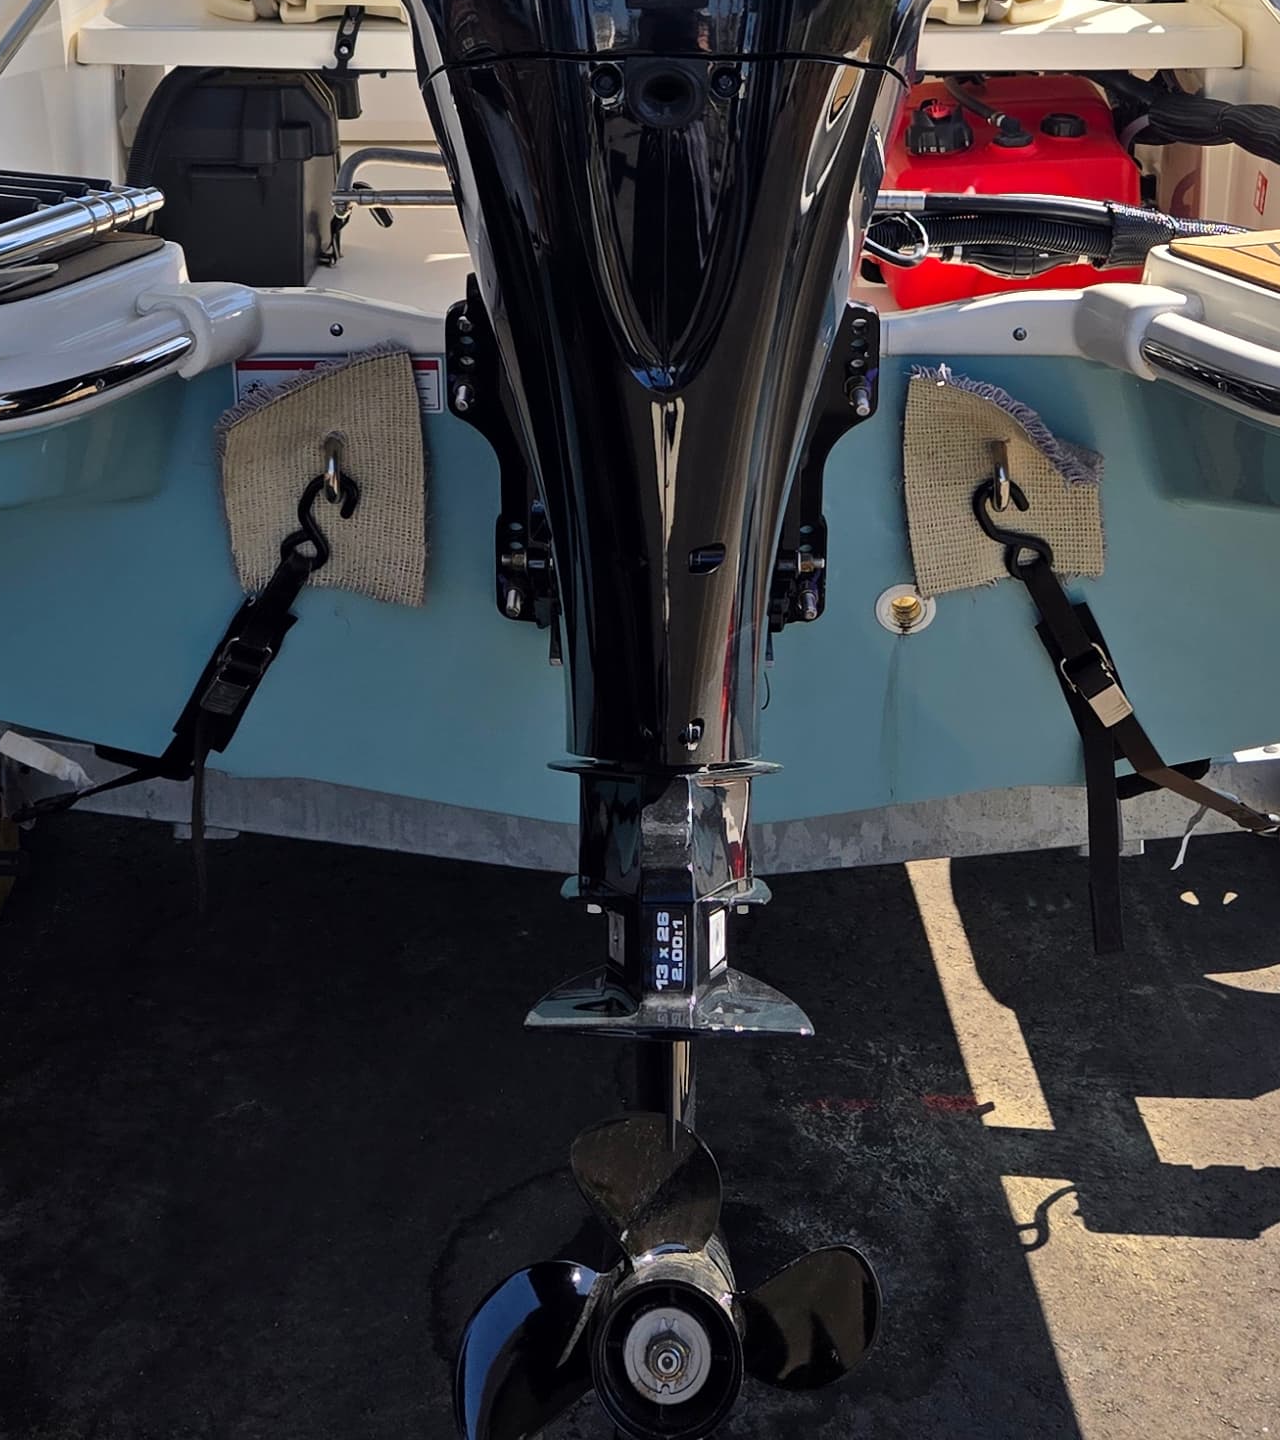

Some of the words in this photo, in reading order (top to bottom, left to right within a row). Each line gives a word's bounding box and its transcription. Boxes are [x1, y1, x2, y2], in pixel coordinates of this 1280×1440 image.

[656, 912, 669, 942] 26
[659, 947, 669, 959] x
[671, 919, 683, 982] 2.00:1
[655, 964, 669, 991] 13
